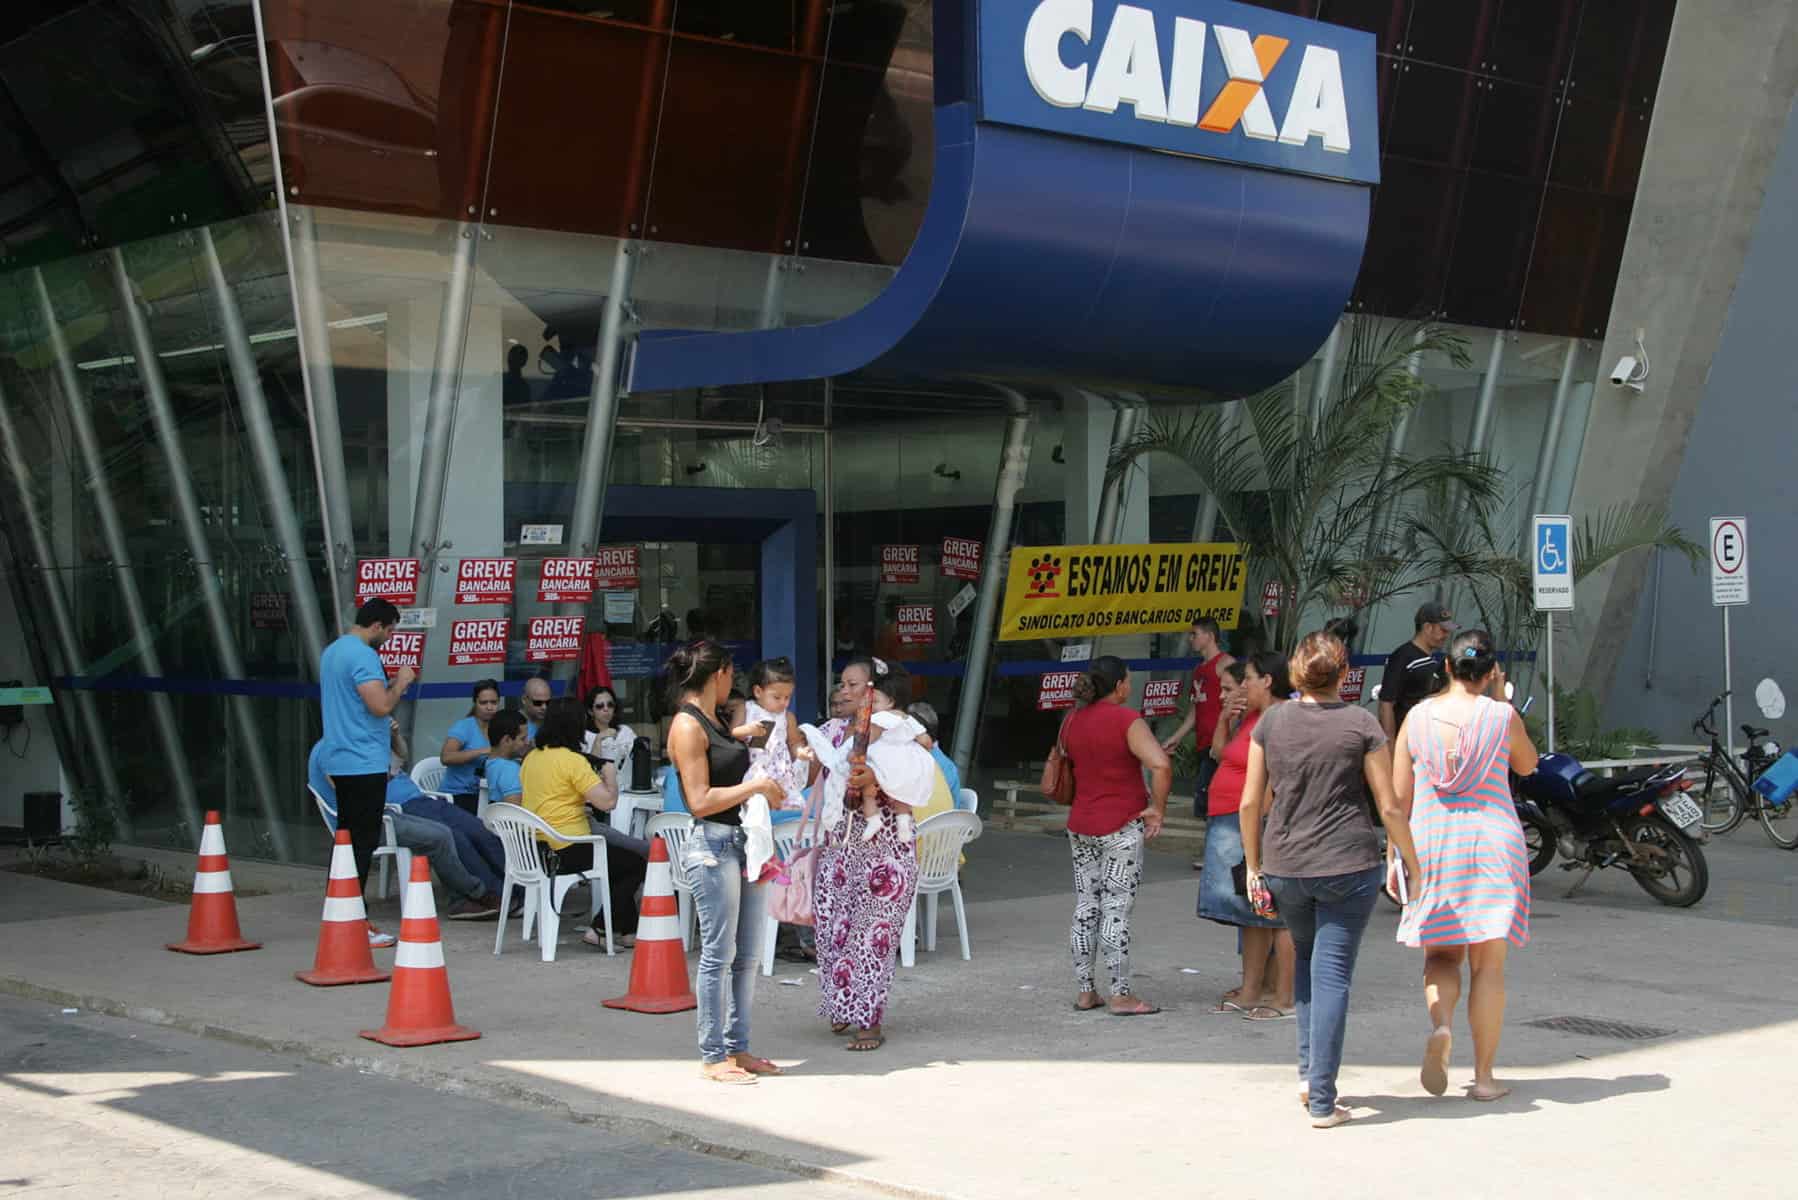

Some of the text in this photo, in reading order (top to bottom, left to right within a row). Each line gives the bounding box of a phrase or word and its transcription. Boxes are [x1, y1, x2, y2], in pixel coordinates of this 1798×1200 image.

[1024, 0, 1350, 154] CAIXA
[882, 547, 918, 561] GREVE
[944, 540, 981, 559] GREVE
[1724, 535, 1735, 561] E
[361, 561, 417, 580] GREVE
[461, 561, 515, 579] GREVE
[543, 560, 595, 577] GREVE
[1067, 553, 1243, 597] ESTAMOS EM GREVE
[359, 579, 414, 594] BANCÁRIA
[459, 578, 511, 592] BANCÁRIA
[541, 576, 591, 590] BANCÁRIA
[897, 607, 933, 622] GREVE
[1018, 613, 1085, 631] SINDICATO
[1087, 611, 1113, 627] DOS
[455, 621, 508, 639] GREVE
[531, 619, 582, 636] GREVE
[379, 635, 423, 652] REVE
[453, 638, 504, 653] BANCÁRIA
[529, 634, 578, 649] BANCÁRIA
[379, 651, 418, 665] NCÁRIA
[1146, 682, 1180, 697] GREVE
